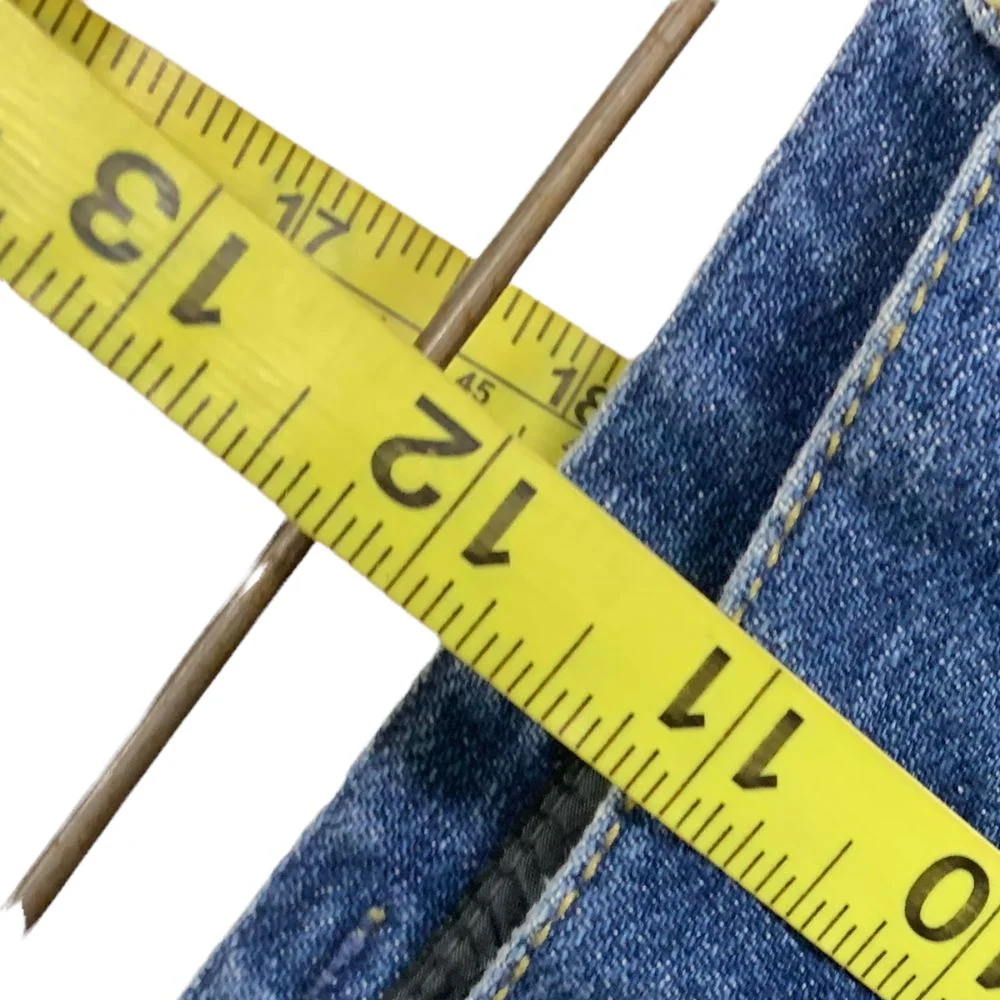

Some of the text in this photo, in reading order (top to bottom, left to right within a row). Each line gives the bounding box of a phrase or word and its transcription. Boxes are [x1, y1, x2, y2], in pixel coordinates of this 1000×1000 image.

[70, 151, 249, 326] 13
[277, 193, 350, 253] 17
[456, 371, 496, 405] 45
[371, 395, 537, 568] 12
[658, 647, 804, 789] 11
